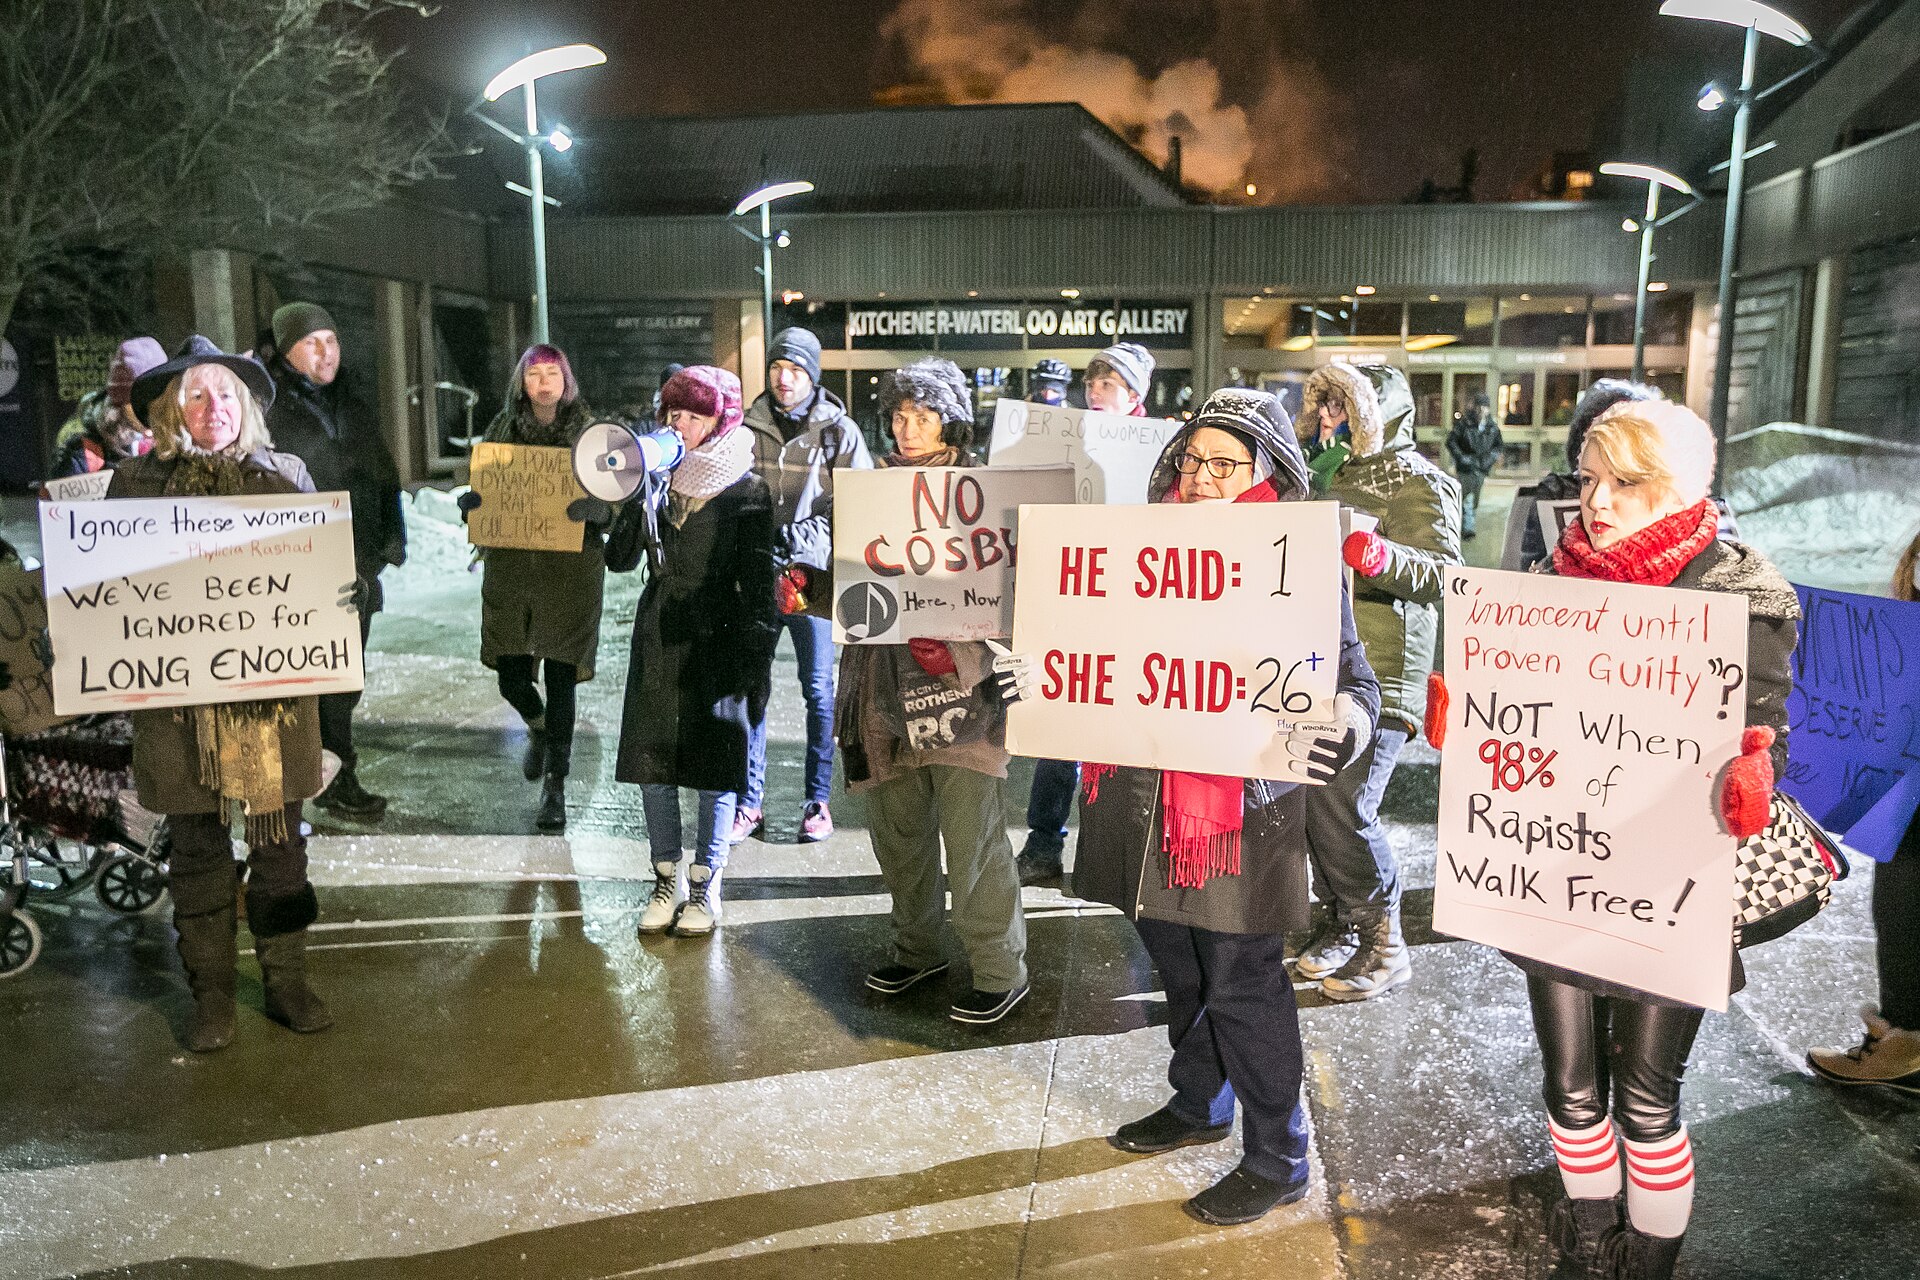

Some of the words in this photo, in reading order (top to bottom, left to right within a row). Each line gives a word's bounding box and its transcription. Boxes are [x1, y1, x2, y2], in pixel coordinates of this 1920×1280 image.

[848, 309, 1058, 336] KITCHENER-WATERLOO
[1059, 309, 1099, 336] ART
[1099, 308, 1188, 336] GALLERY
[1061, 417, 1085, 439] 20
[1099, 423, 1166, 445] WOMEN
[523, 448, 570, 473] POWE
[171, 505, 235, 535] these
[912, 471, 984, 533] NO
[1059, 547, 1108, 597] HE
[1134, 546, 1241, 601] SAID:
[1270, 534, 1292, 597] 1
[62, 576, 172, 610] WE'VE
[205, 573, 291, 601] BEEN
[123, 611, 255, 640] IGNORED
[272, 604, 318, 629] for
[80, 655, 190, 694] LONG
[210, 637, 350, 681] ENOUGH
[1463, 637, 1560, 674] Proven
[1041, 649, 1116, 706] SHE
[1137, 652, 1247, 713] SAID:
[1464, 692, 1553, 738] NOT
[1579, 711, 1701, 764] When
[1479, 738, 1558, 792] 98%
[1586, 765, 1624, 807] of
[1468, 793, 1611, 861] Rapists
